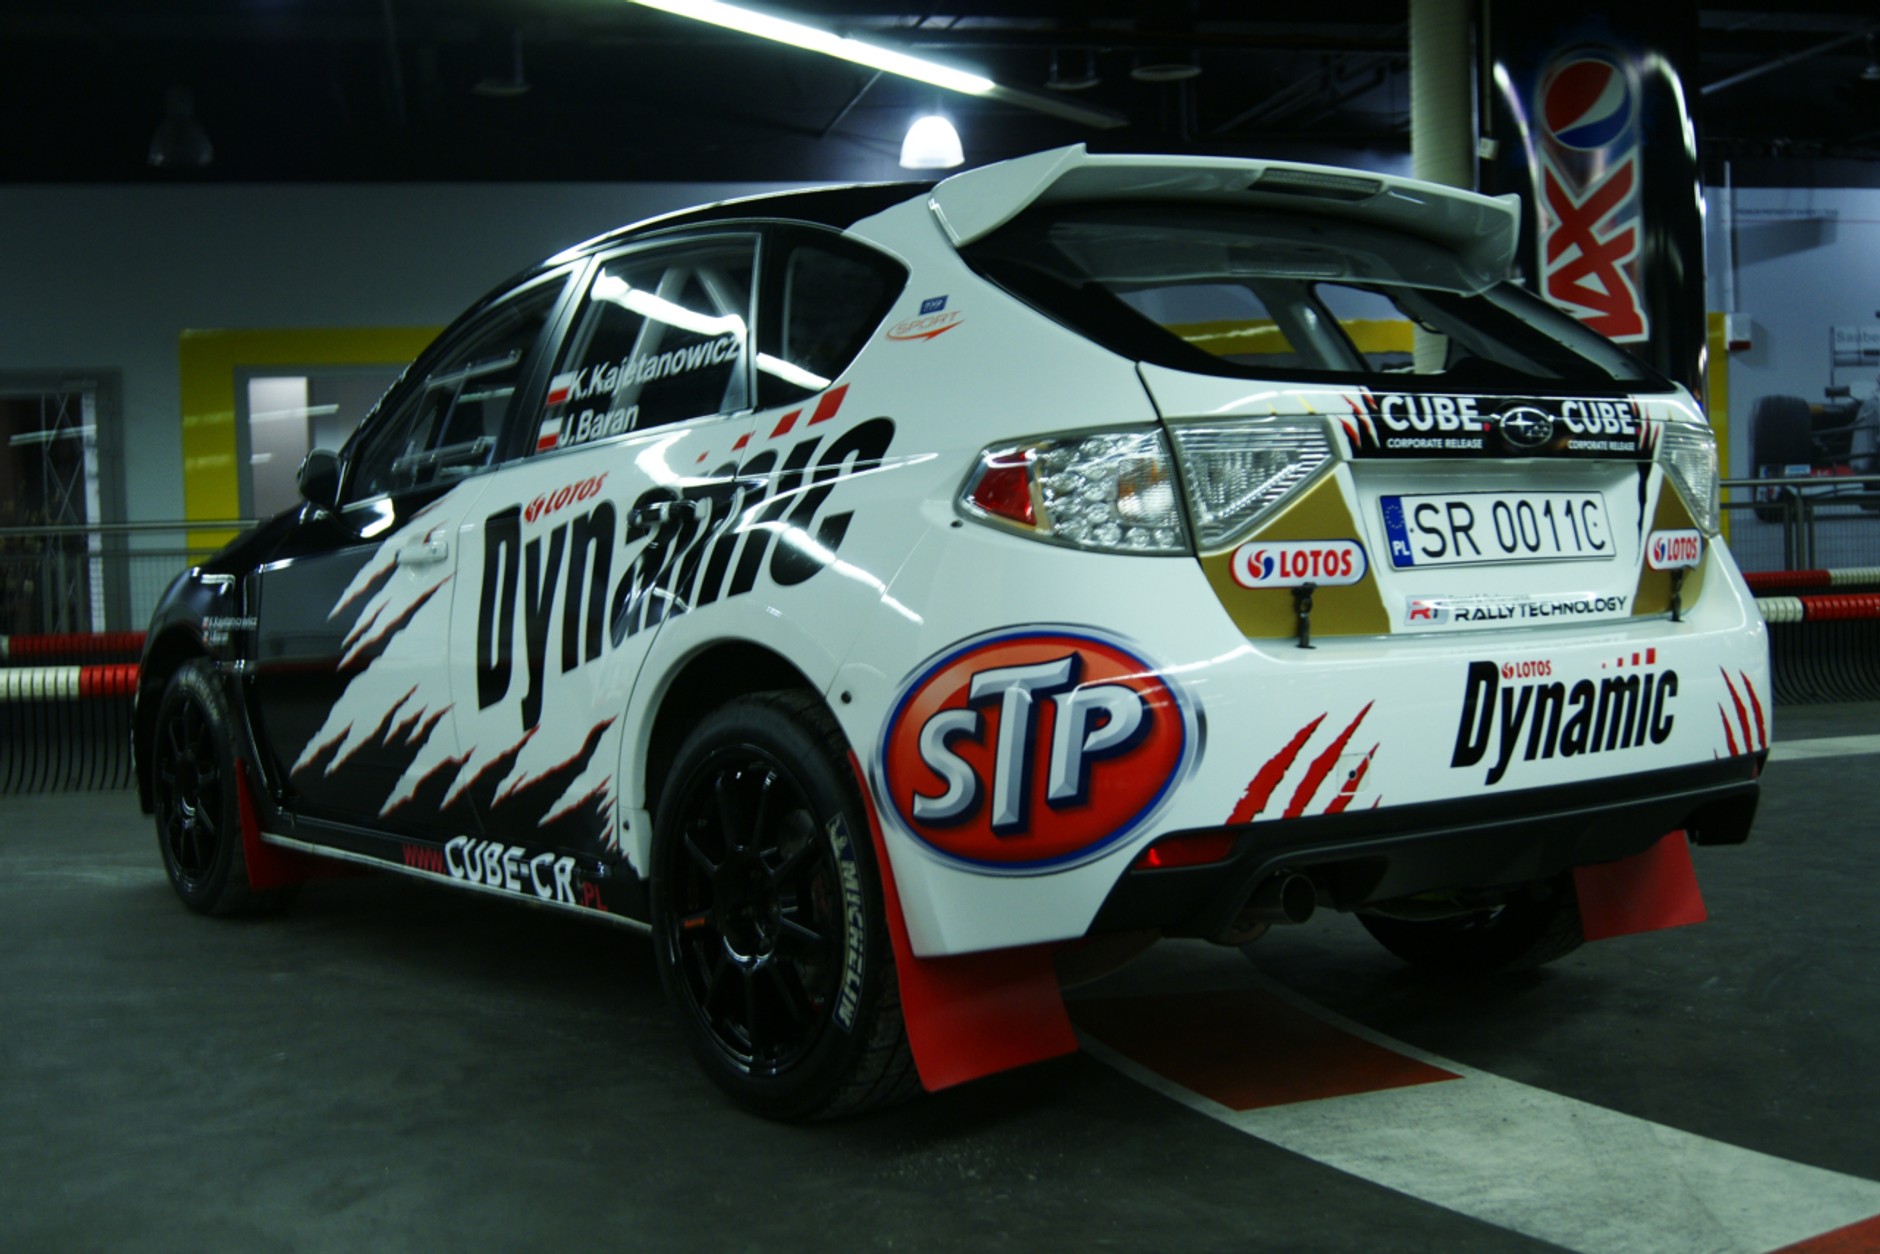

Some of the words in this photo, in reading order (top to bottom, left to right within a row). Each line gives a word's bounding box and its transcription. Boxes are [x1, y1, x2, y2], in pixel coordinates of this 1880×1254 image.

[896, 309, 962, 335] SPORT
[567, 336, 741, 403] K.Kajetanowicz
[559, 404, 640, 448] J.Baran
[1386, 438, 1443, 450] CORPORATE
[1445, 438, 1483, 449] RELEASE
[543, 471, 609, 516] LOTOS
[1392, 540, 1411, 555] PL
[1414, 501, 1482, 558] SR
[1491, 498, 1606, 554] 0011C
[1667, 537, 1698, 561] LOTOS
[476, 383, 897, 732] Dynamic
[1280, 549, 1353, 578] LOTOS
[1516, 661, 1552, 678] LOTOS
[1449, 648, 1679, 785] Dynamic
[911, 652, 1153, 835] STP
[838, 860, 865, 1028] MICHELIN
